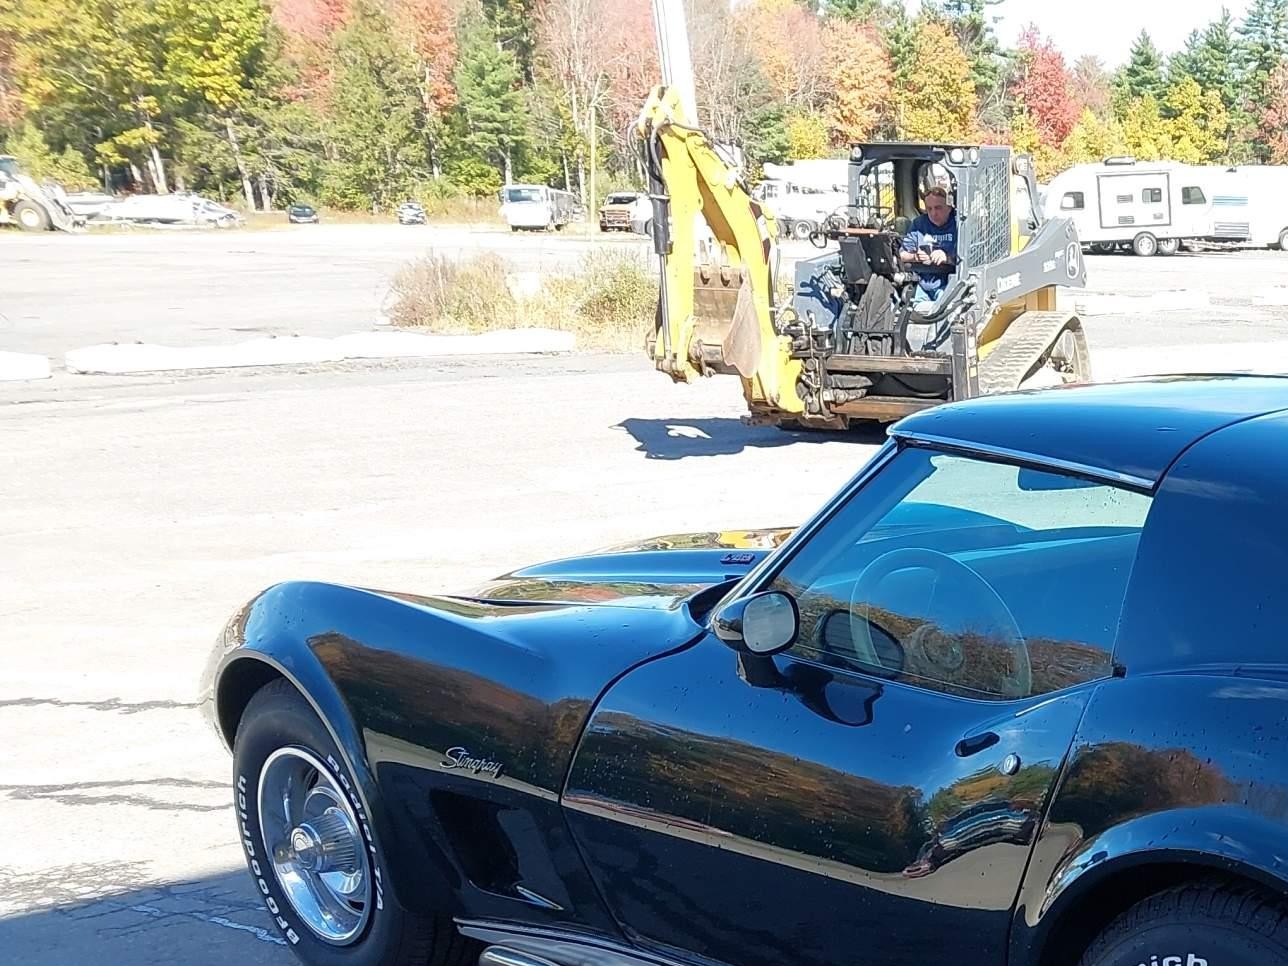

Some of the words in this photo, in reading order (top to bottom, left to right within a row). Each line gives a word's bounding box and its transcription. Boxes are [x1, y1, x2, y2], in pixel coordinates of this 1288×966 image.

[327, 754, 376, 854] Radial
[373, 867, 384, 910] T/A
[440, 746, 503, 779] Stingray
[237, 775, 300, 944] BFGoodrich
